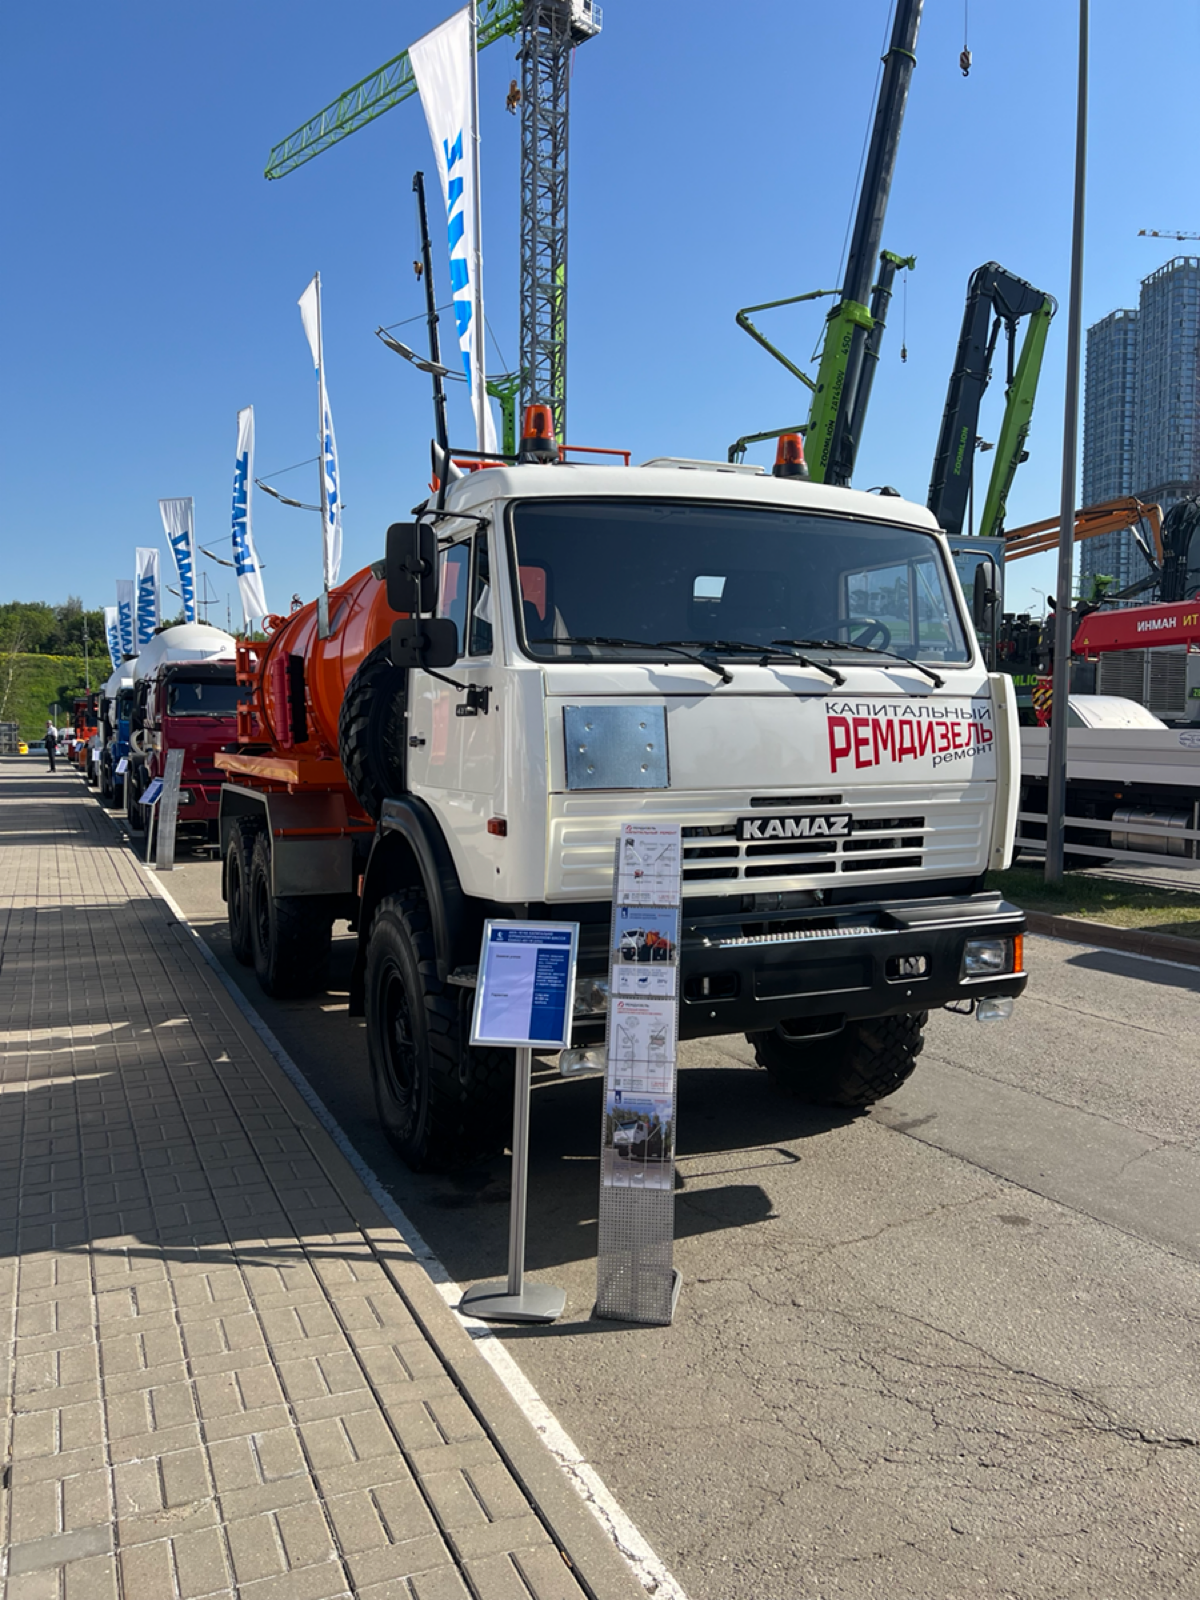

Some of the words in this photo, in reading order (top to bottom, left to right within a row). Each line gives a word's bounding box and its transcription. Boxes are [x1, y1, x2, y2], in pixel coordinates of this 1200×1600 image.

[820, 420, 835, 468] ZOOMLION
[953, 426, 969, 476] ZOOMLION
[231, 451, 255, 577] KAMAZ
[1136, 616, 1177, 633] ИНМАН
[825, 702, 992, 720] КАПИТАЛЬНЫЙ
[827, 715, 993, 774] РЕМДИЗЕЛЬ
[932, 742, 994, 768] ремонт
[742, 815, 849, 840] KAMAZ
